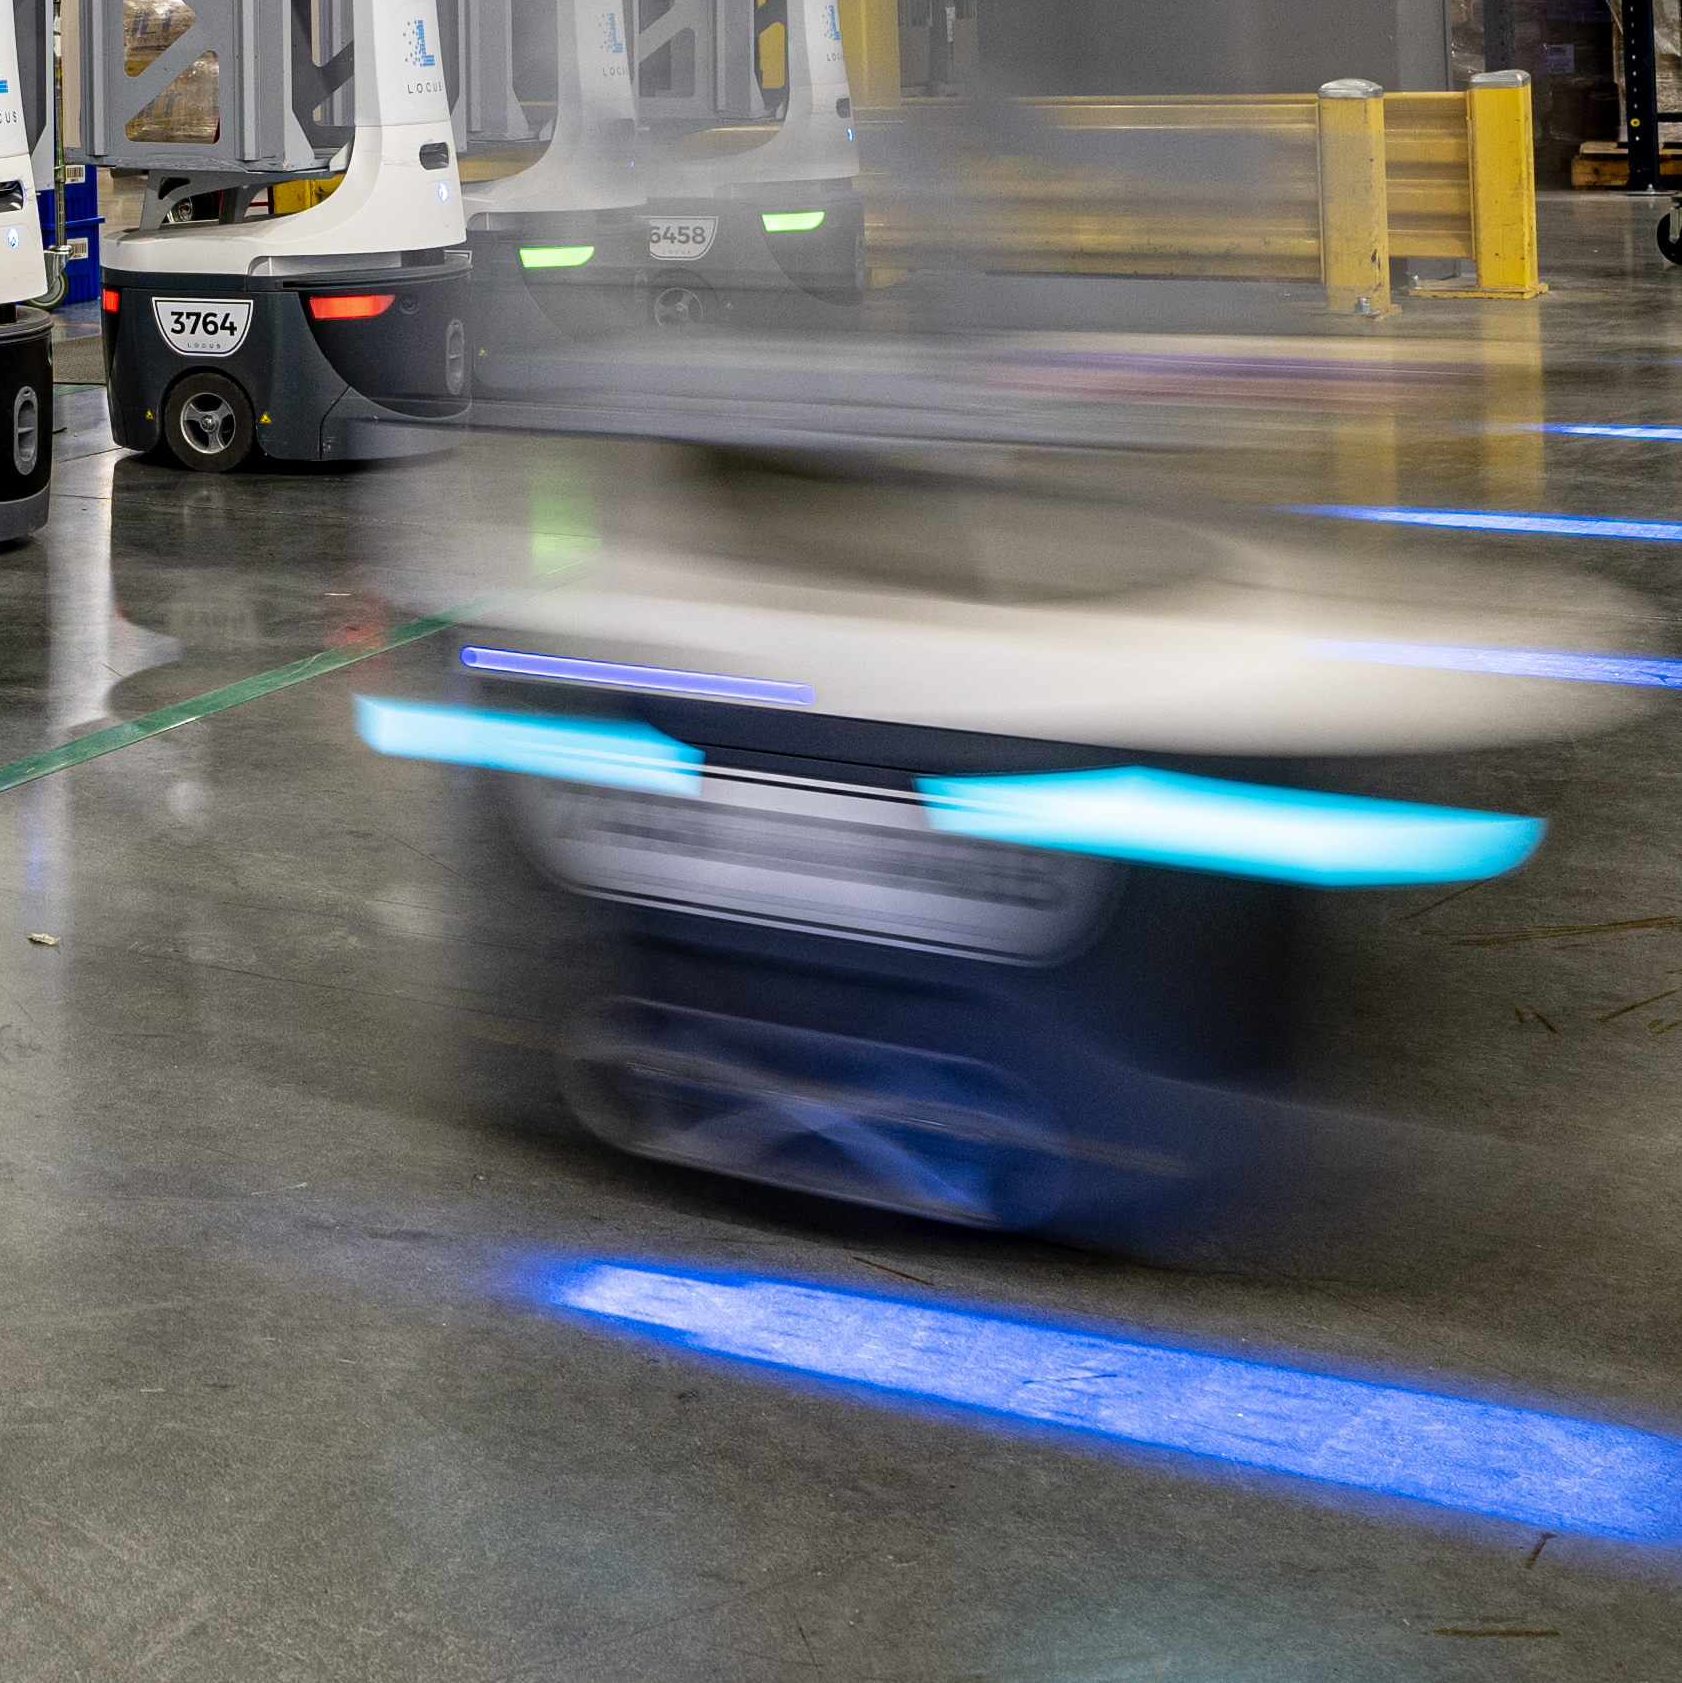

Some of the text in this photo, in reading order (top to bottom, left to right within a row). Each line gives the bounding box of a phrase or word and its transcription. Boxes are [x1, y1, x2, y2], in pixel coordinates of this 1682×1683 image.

[407, 81, 443, 95] LOCUS
[649, 225, 707, 245] 6458
[170, 311, 238, 337] 3764
